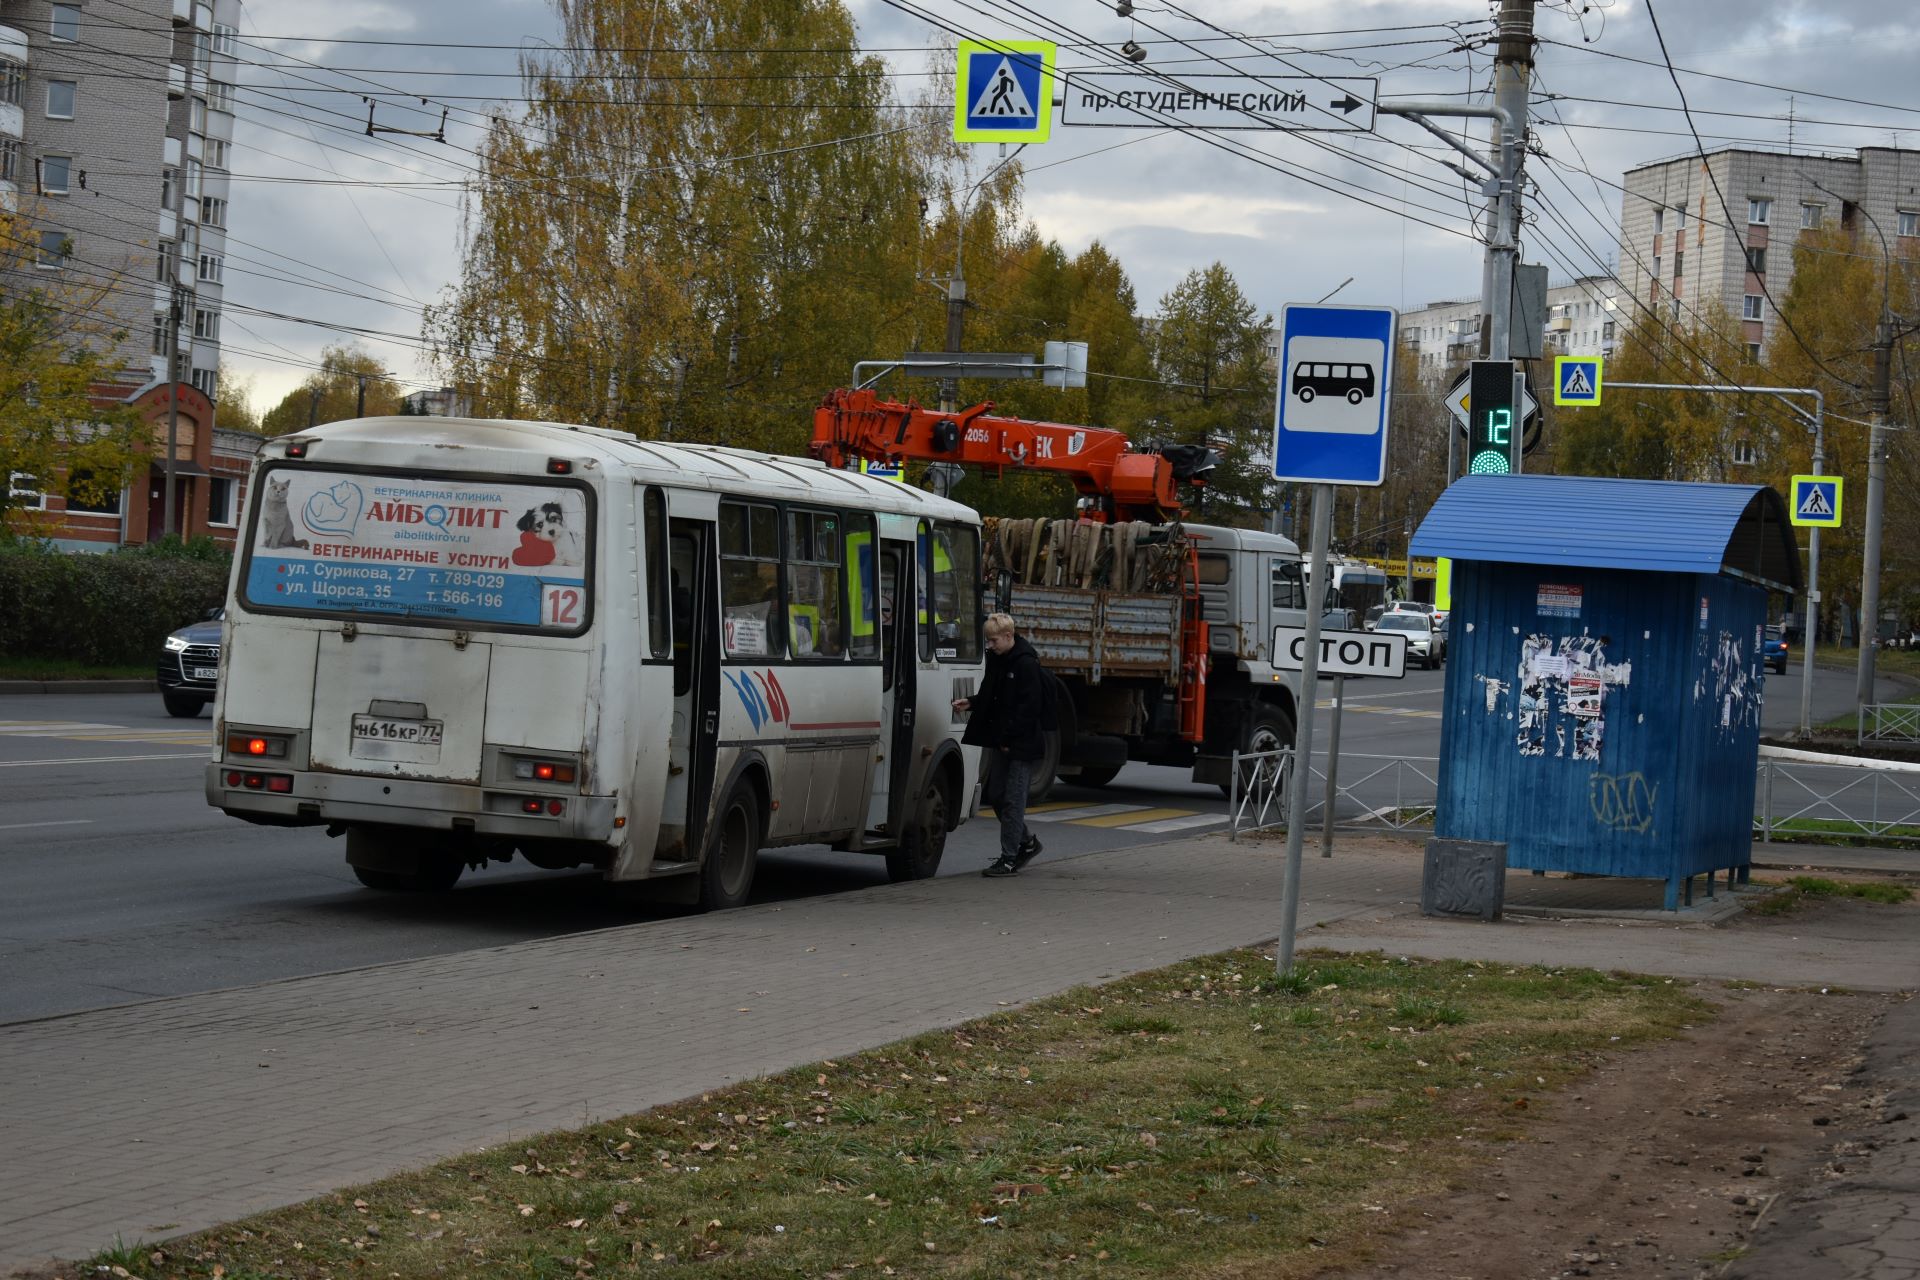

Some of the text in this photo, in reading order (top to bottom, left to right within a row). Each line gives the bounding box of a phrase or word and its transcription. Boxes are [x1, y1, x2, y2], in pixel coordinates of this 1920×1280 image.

[964, 428, 989, 443] 2056
[1488, 409, 1511, 444] 12
[374, 487, 502, 502] ВЕТЕРИНАРНАЯ КЛИНИКА
[364, 498, 509, 529] АЙБОЛИТ
[394, 529, 470, 543] aibolitkirov.ru
[313, 543, 509, 569] ВЕТЕРИНАРНЫЕ УСЛУГИ
[287, 562, 505, 589] ул. Сурикова, 27 т. 789-029
[285, 580, 503, 608] ул. Щорса, 35 т. 566-196
[549, 589, 579, 624] 12
[726, 621, 735, 650] 12
[1289, 636, 1391, 668] СТОП
[358, 722, 437, 740] Н616КР 77
